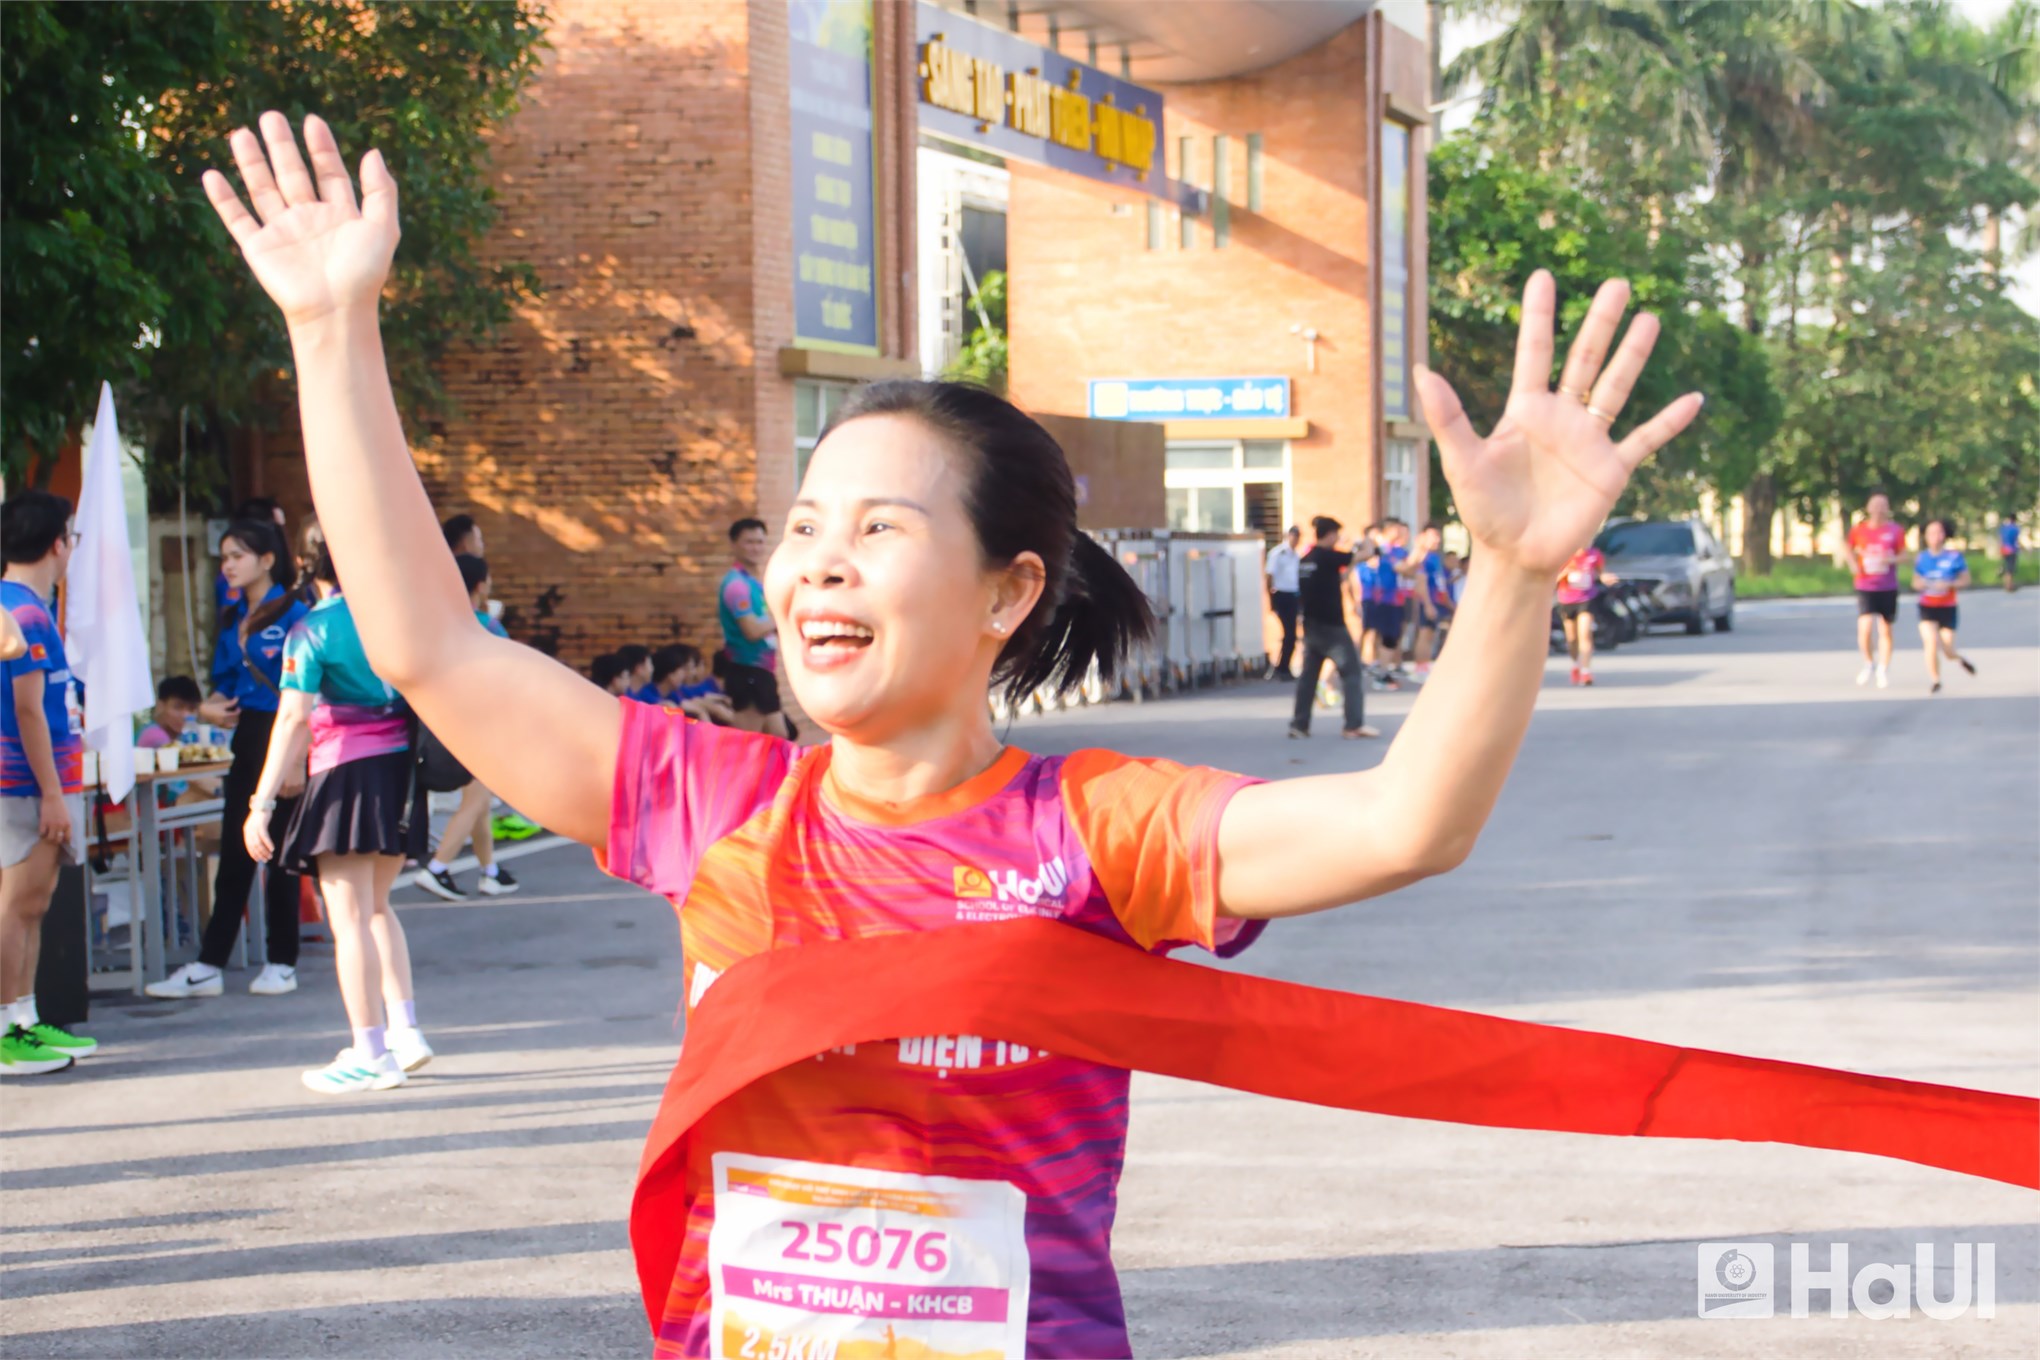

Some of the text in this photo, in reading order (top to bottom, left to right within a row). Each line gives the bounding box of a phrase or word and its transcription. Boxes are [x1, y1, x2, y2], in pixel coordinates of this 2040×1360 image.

[781, 1220, 947, 1273] 25076
[753, 1278, 793, 1301] Mrs
[799, 1284, 884, 1315] THUẬN
[907, 1295, 973, 1315] KHCB
